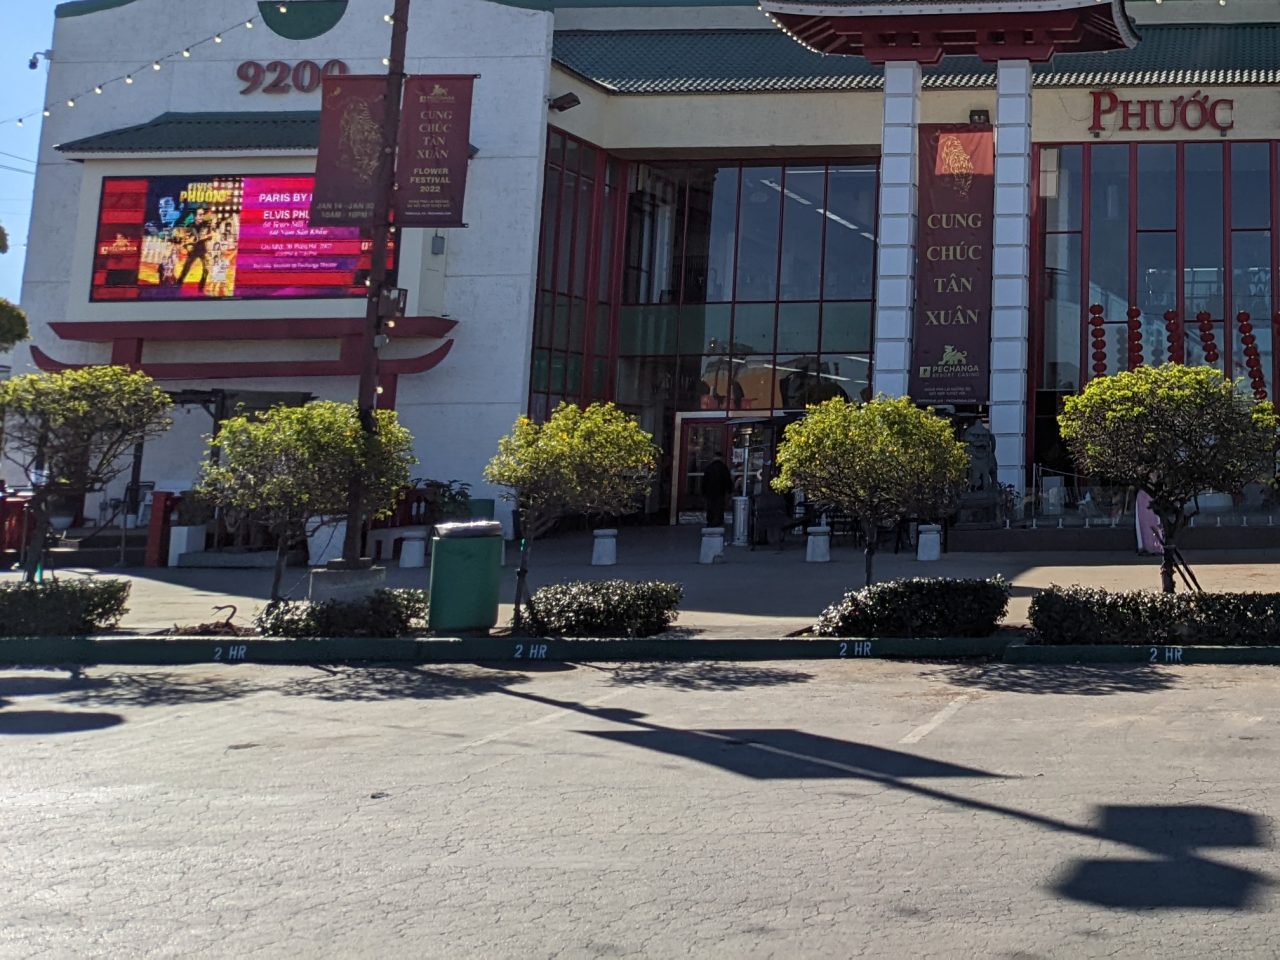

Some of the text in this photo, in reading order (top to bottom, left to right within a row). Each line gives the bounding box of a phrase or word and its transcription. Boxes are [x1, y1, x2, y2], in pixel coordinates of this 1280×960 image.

[420, 111, 453, 120] CUNG
[410, 176, 452, 184] FESTIVAL
[419, 185, 441, 193] 2022
[259, 193, 291, 202] PARIS
[293, 193, 307, 202] BY
[264, 210, 291, 219] ELVIS
[927, 213, 983, 229] CUNG
[926, 240, 983, 261] CHÚC
[934, 272, 973, 293] TÂN
[925, 305, 979, 326] XUÂN
[932, 365, 980, 373] PECHANGA
[214, 645, 247, 660] 2 HR
[514, 644, 547, 658] 2 HR
[840, 642, 872, 656] 2 HR
[1150, 647, 1183, 661] 2 HR
